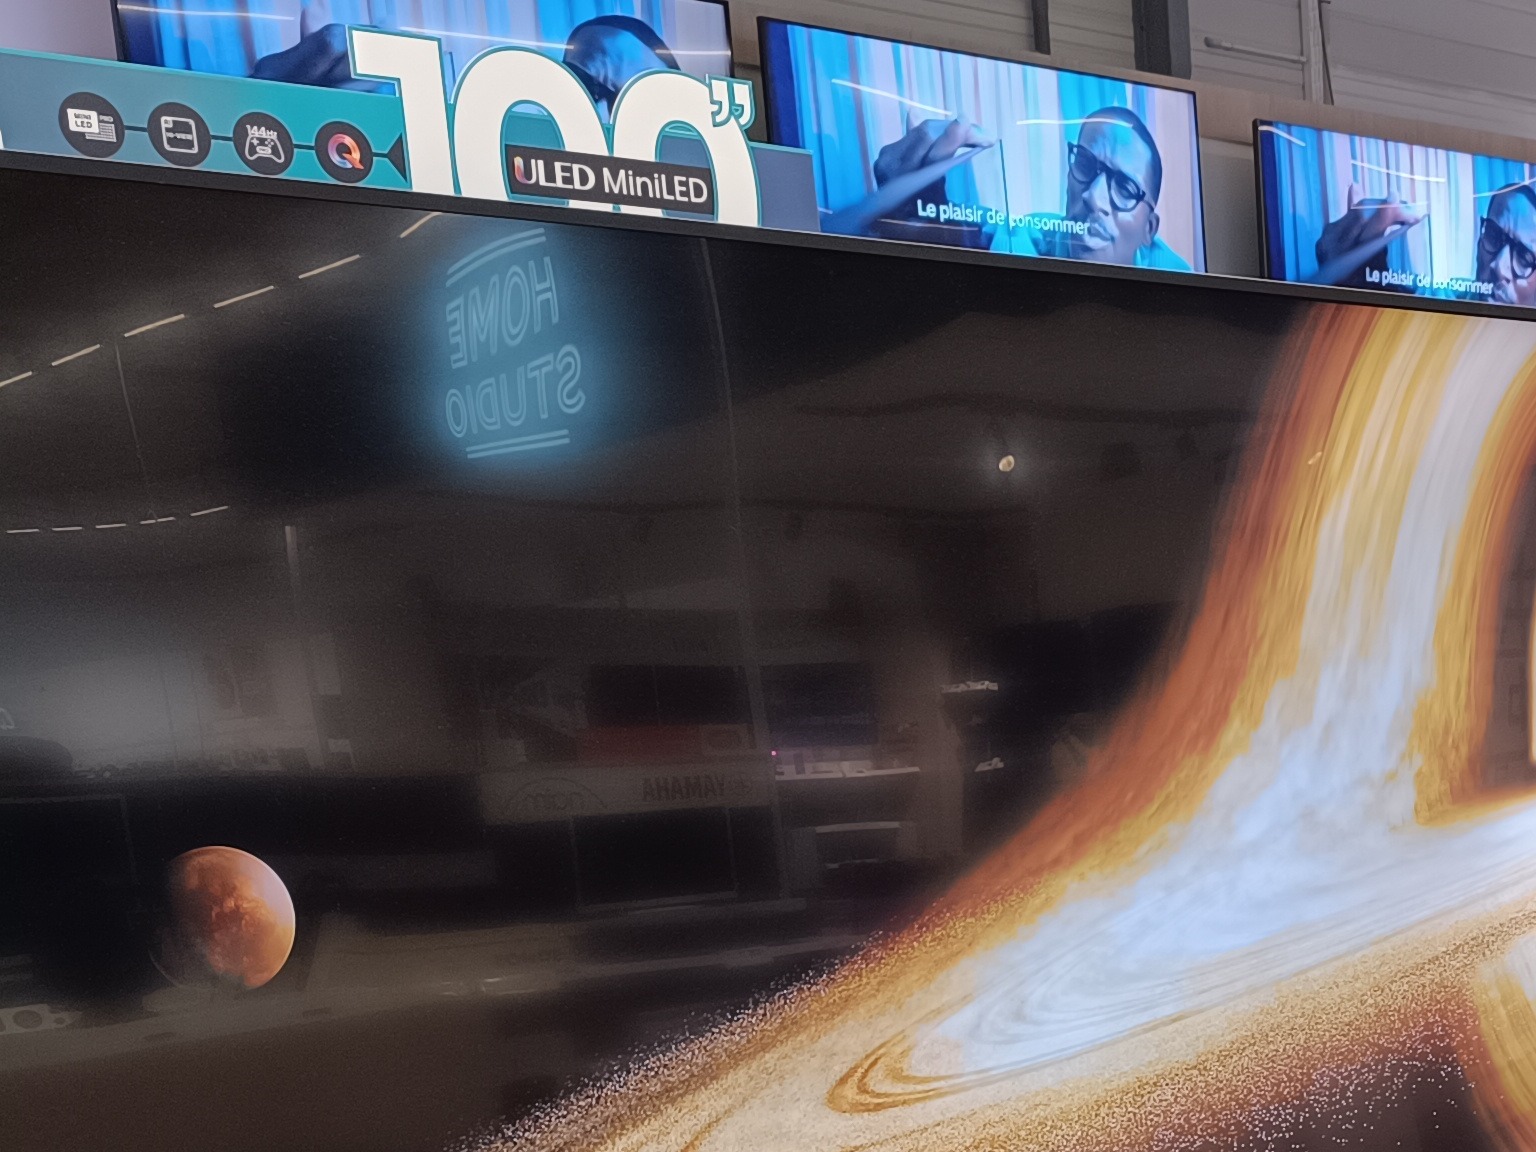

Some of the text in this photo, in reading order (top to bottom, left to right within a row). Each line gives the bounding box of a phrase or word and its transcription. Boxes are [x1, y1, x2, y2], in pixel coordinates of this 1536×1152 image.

[75, 120, 92, 128] LED
[514, 156, 708, 203] ULED MiniLED
[917, 199, 1091, 235] Le plaisir de consommer
[1366, 266, 1493, 294] Le plaisir de consommer
